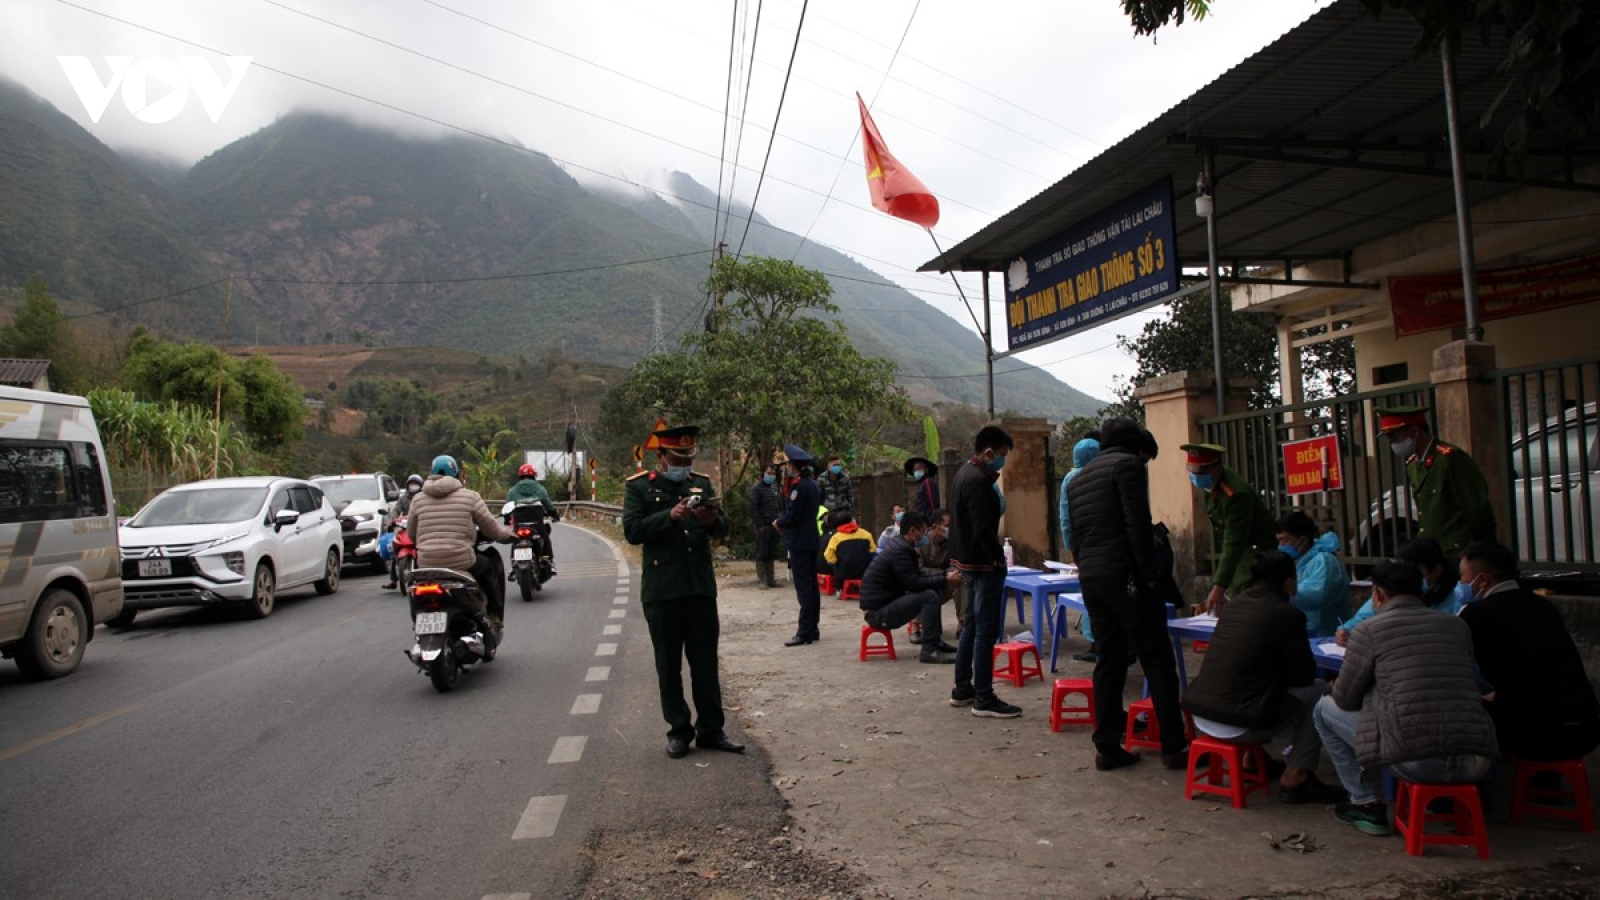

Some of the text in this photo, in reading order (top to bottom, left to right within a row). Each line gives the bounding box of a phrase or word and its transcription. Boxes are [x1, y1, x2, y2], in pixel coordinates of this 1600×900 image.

[1035, 256, 1052, 272] THANH
[1052, 251, 1063, 264] TRA
[1072, 240, 1085, 255] GIAO
[1086, 229, 1106, 248] THÔNG
[1107, 222, 1120, 240] VẬN
[1132, 210, 1143, 227] LAI
[1144, 200, 1162, 220] CHÂU
[1010, 294, 1025, 330] ĐỘI
[1025, 286, 1057, 321] THANH
[1057, 277, 1076, 309] TRA
[1076, 267, 1099, 302] GIAO
[1100, 251, 1136, 292] THÔNG
[1137, 231, 1153, 276] SỐ
[1155, 238, 1165, 270] 3
[1288, 463, 1338, 487] KHAI BÁO TẾ
